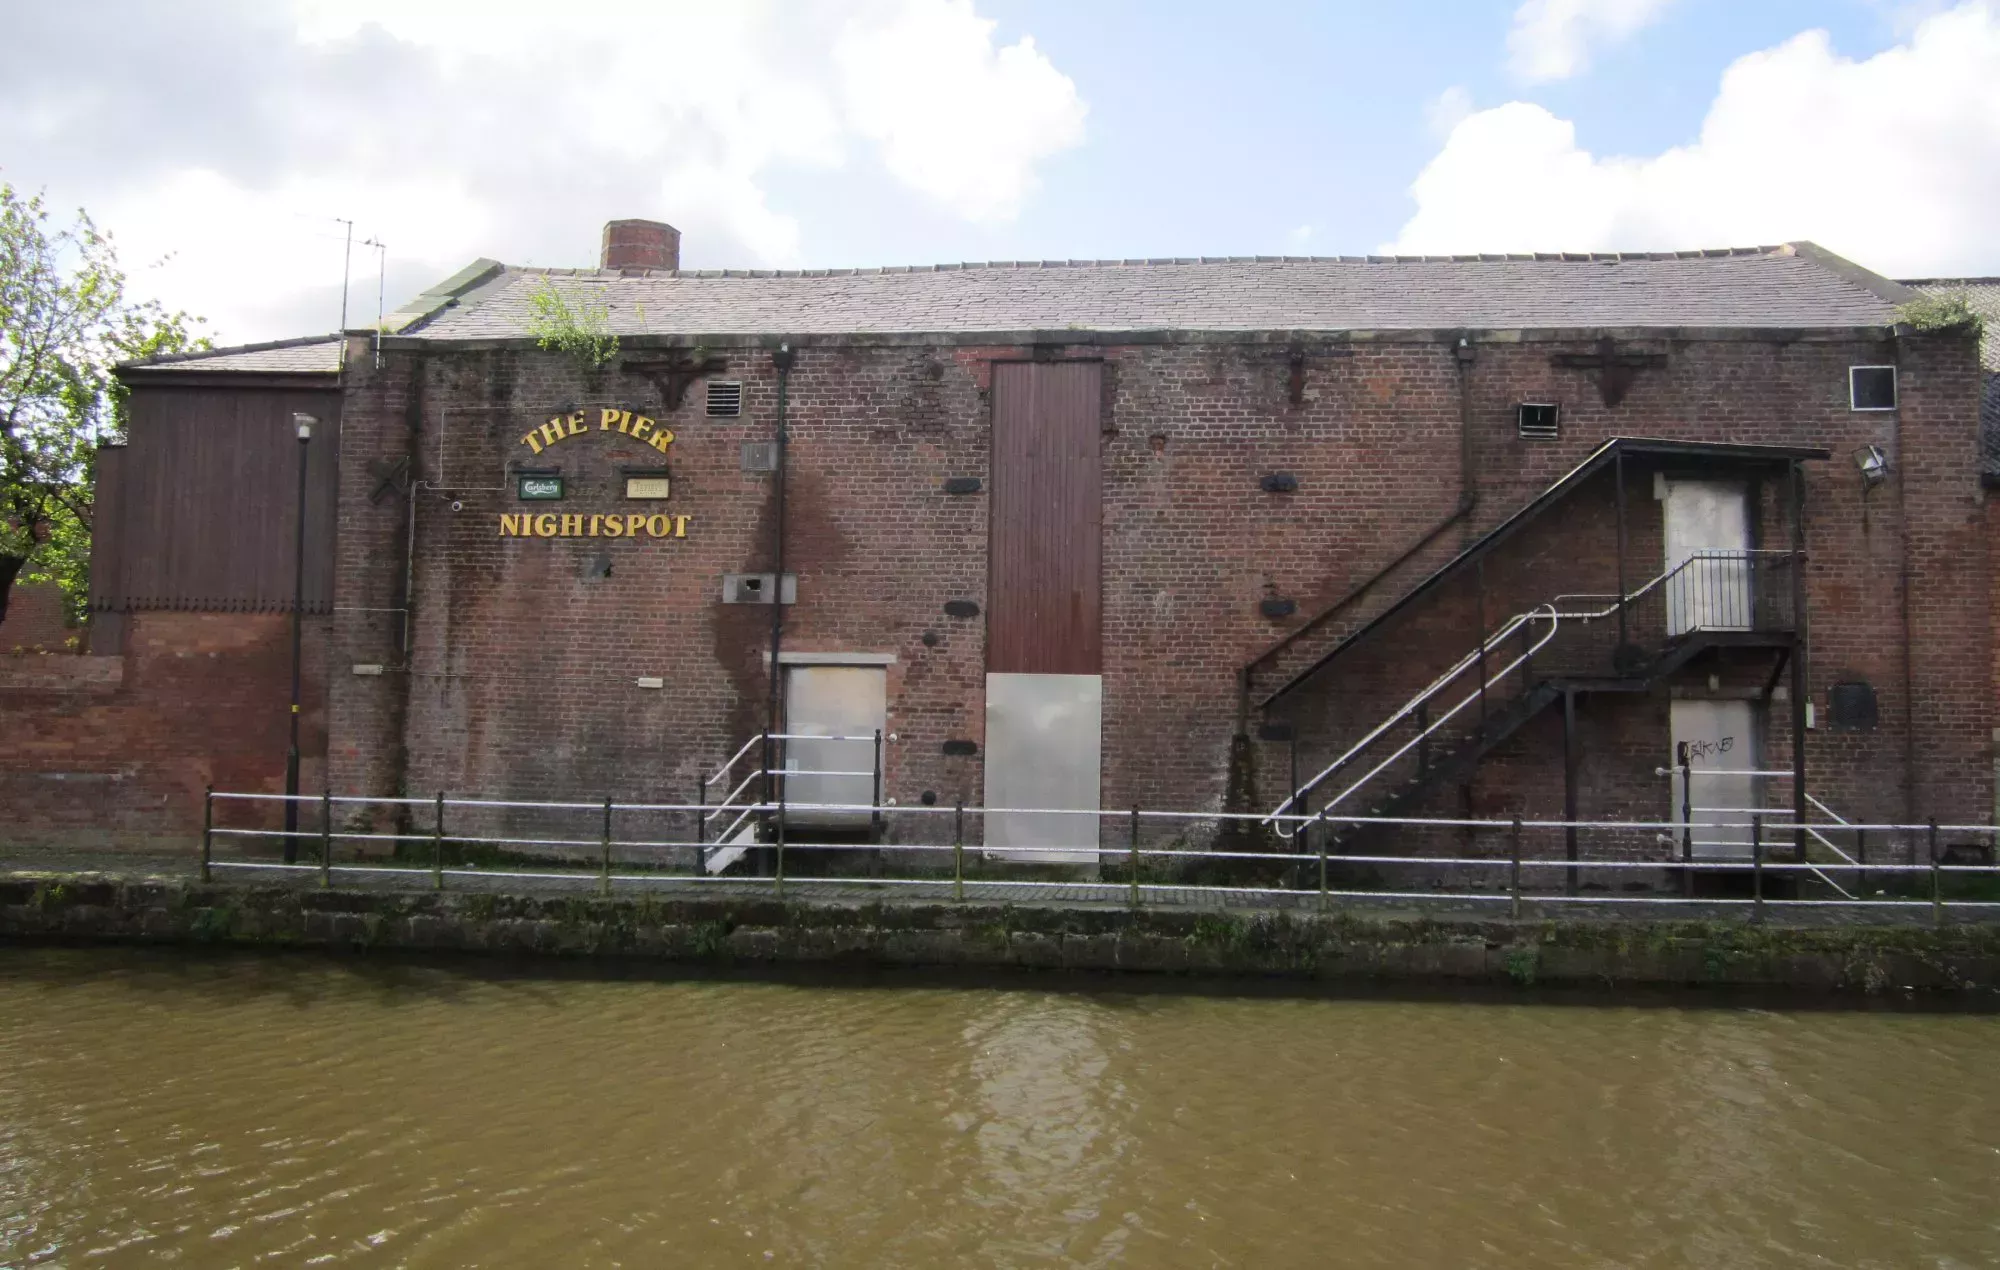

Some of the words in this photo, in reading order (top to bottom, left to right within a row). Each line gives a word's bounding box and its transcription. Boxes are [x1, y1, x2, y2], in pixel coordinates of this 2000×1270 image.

[520, 410, 588, 454] THE
[600, 408, 676, 453] PIER
[524, 481, 558, 494] Carlsberg
[499, 513, 691, 537] NIGHTSPOT
